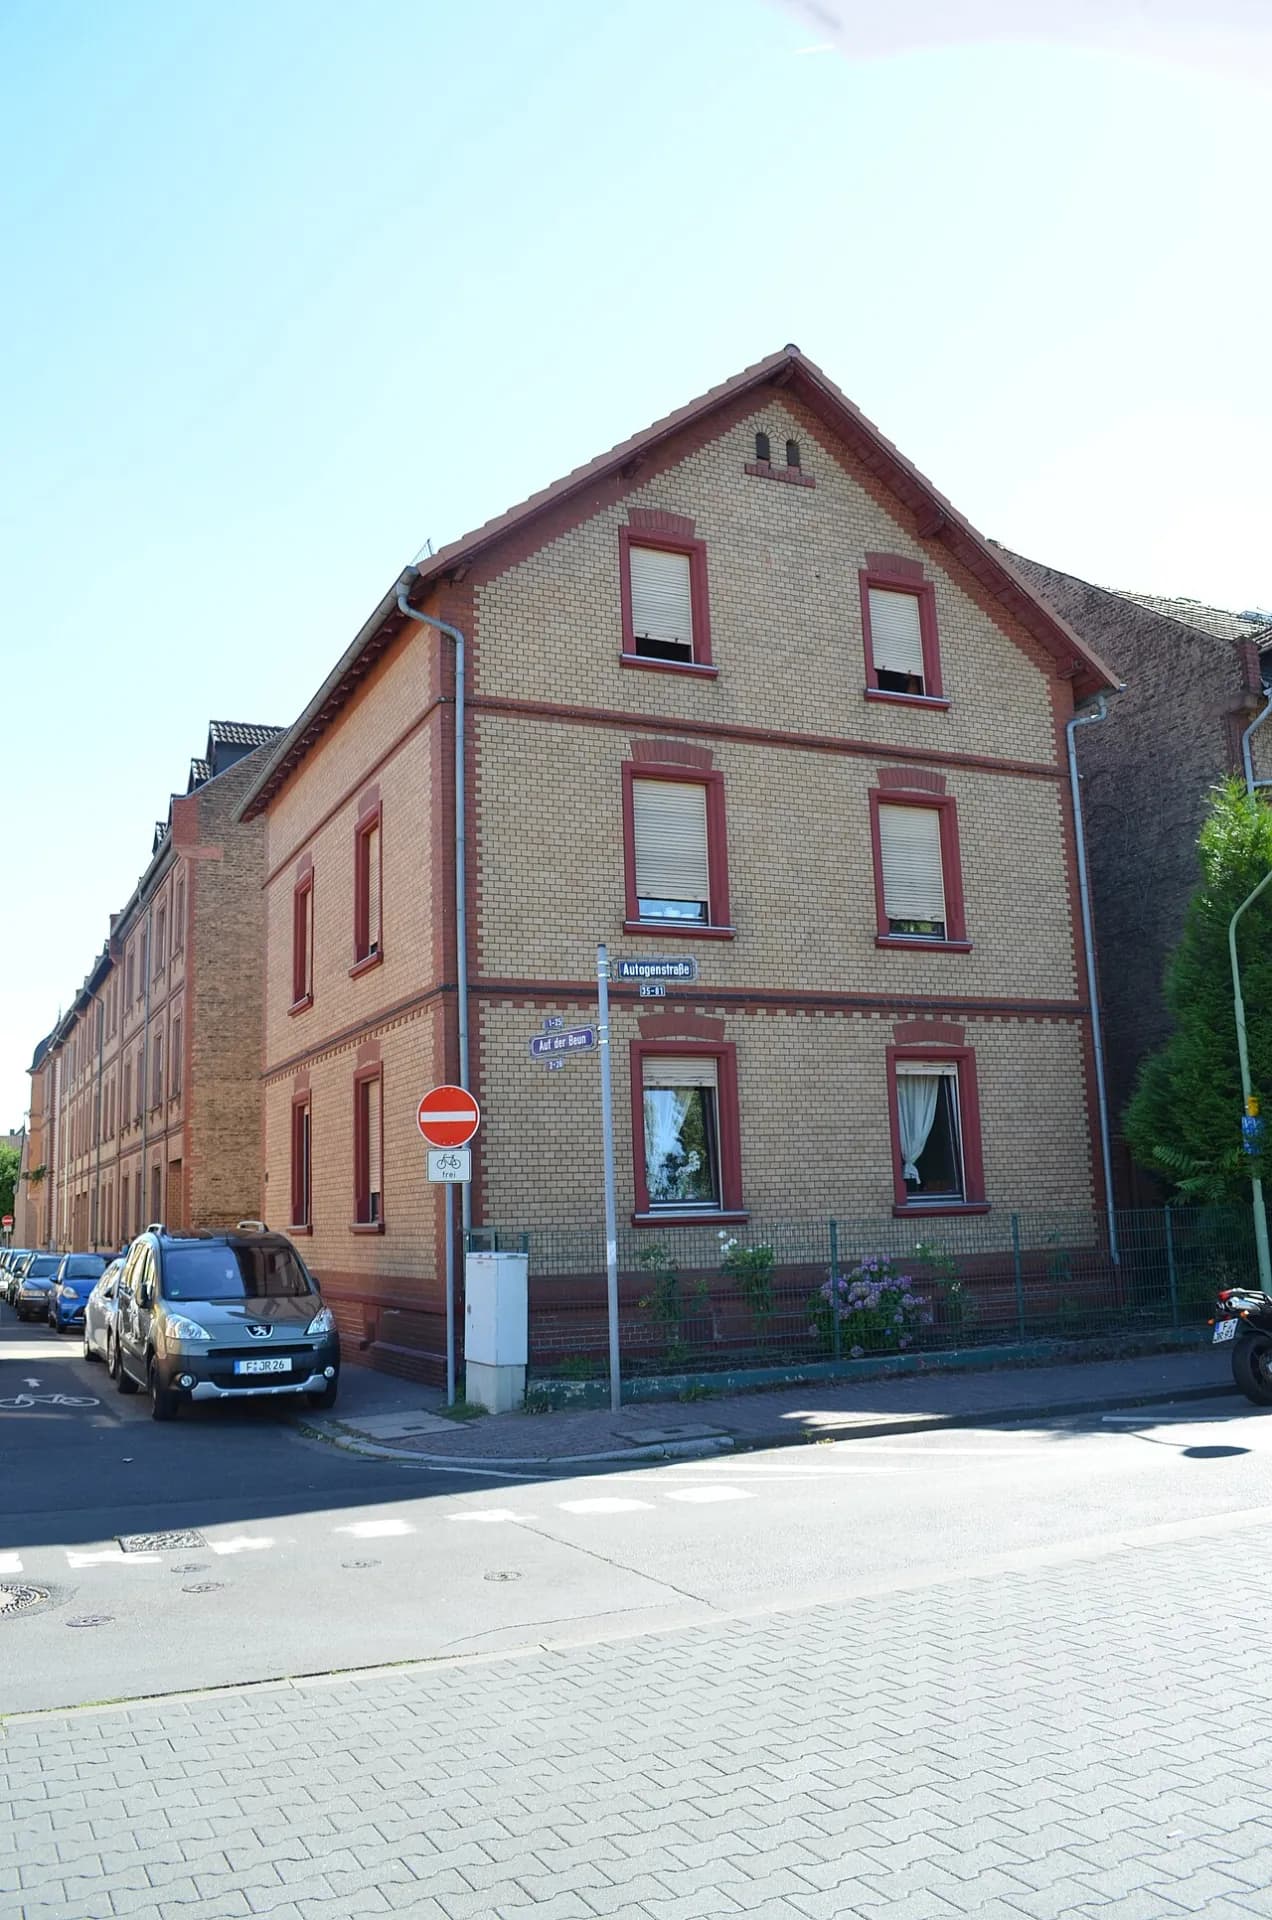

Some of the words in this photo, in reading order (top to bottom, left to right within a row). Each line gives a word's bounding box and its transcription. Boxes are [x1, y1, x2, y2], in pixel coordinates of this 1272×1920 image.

[623, 963, 690, 977] Autogenstraße
[539, 1039, 551, 1052] Auf
[554, 1038, 566, 1048] der
[568, 1035, 586, 1046] Beun
